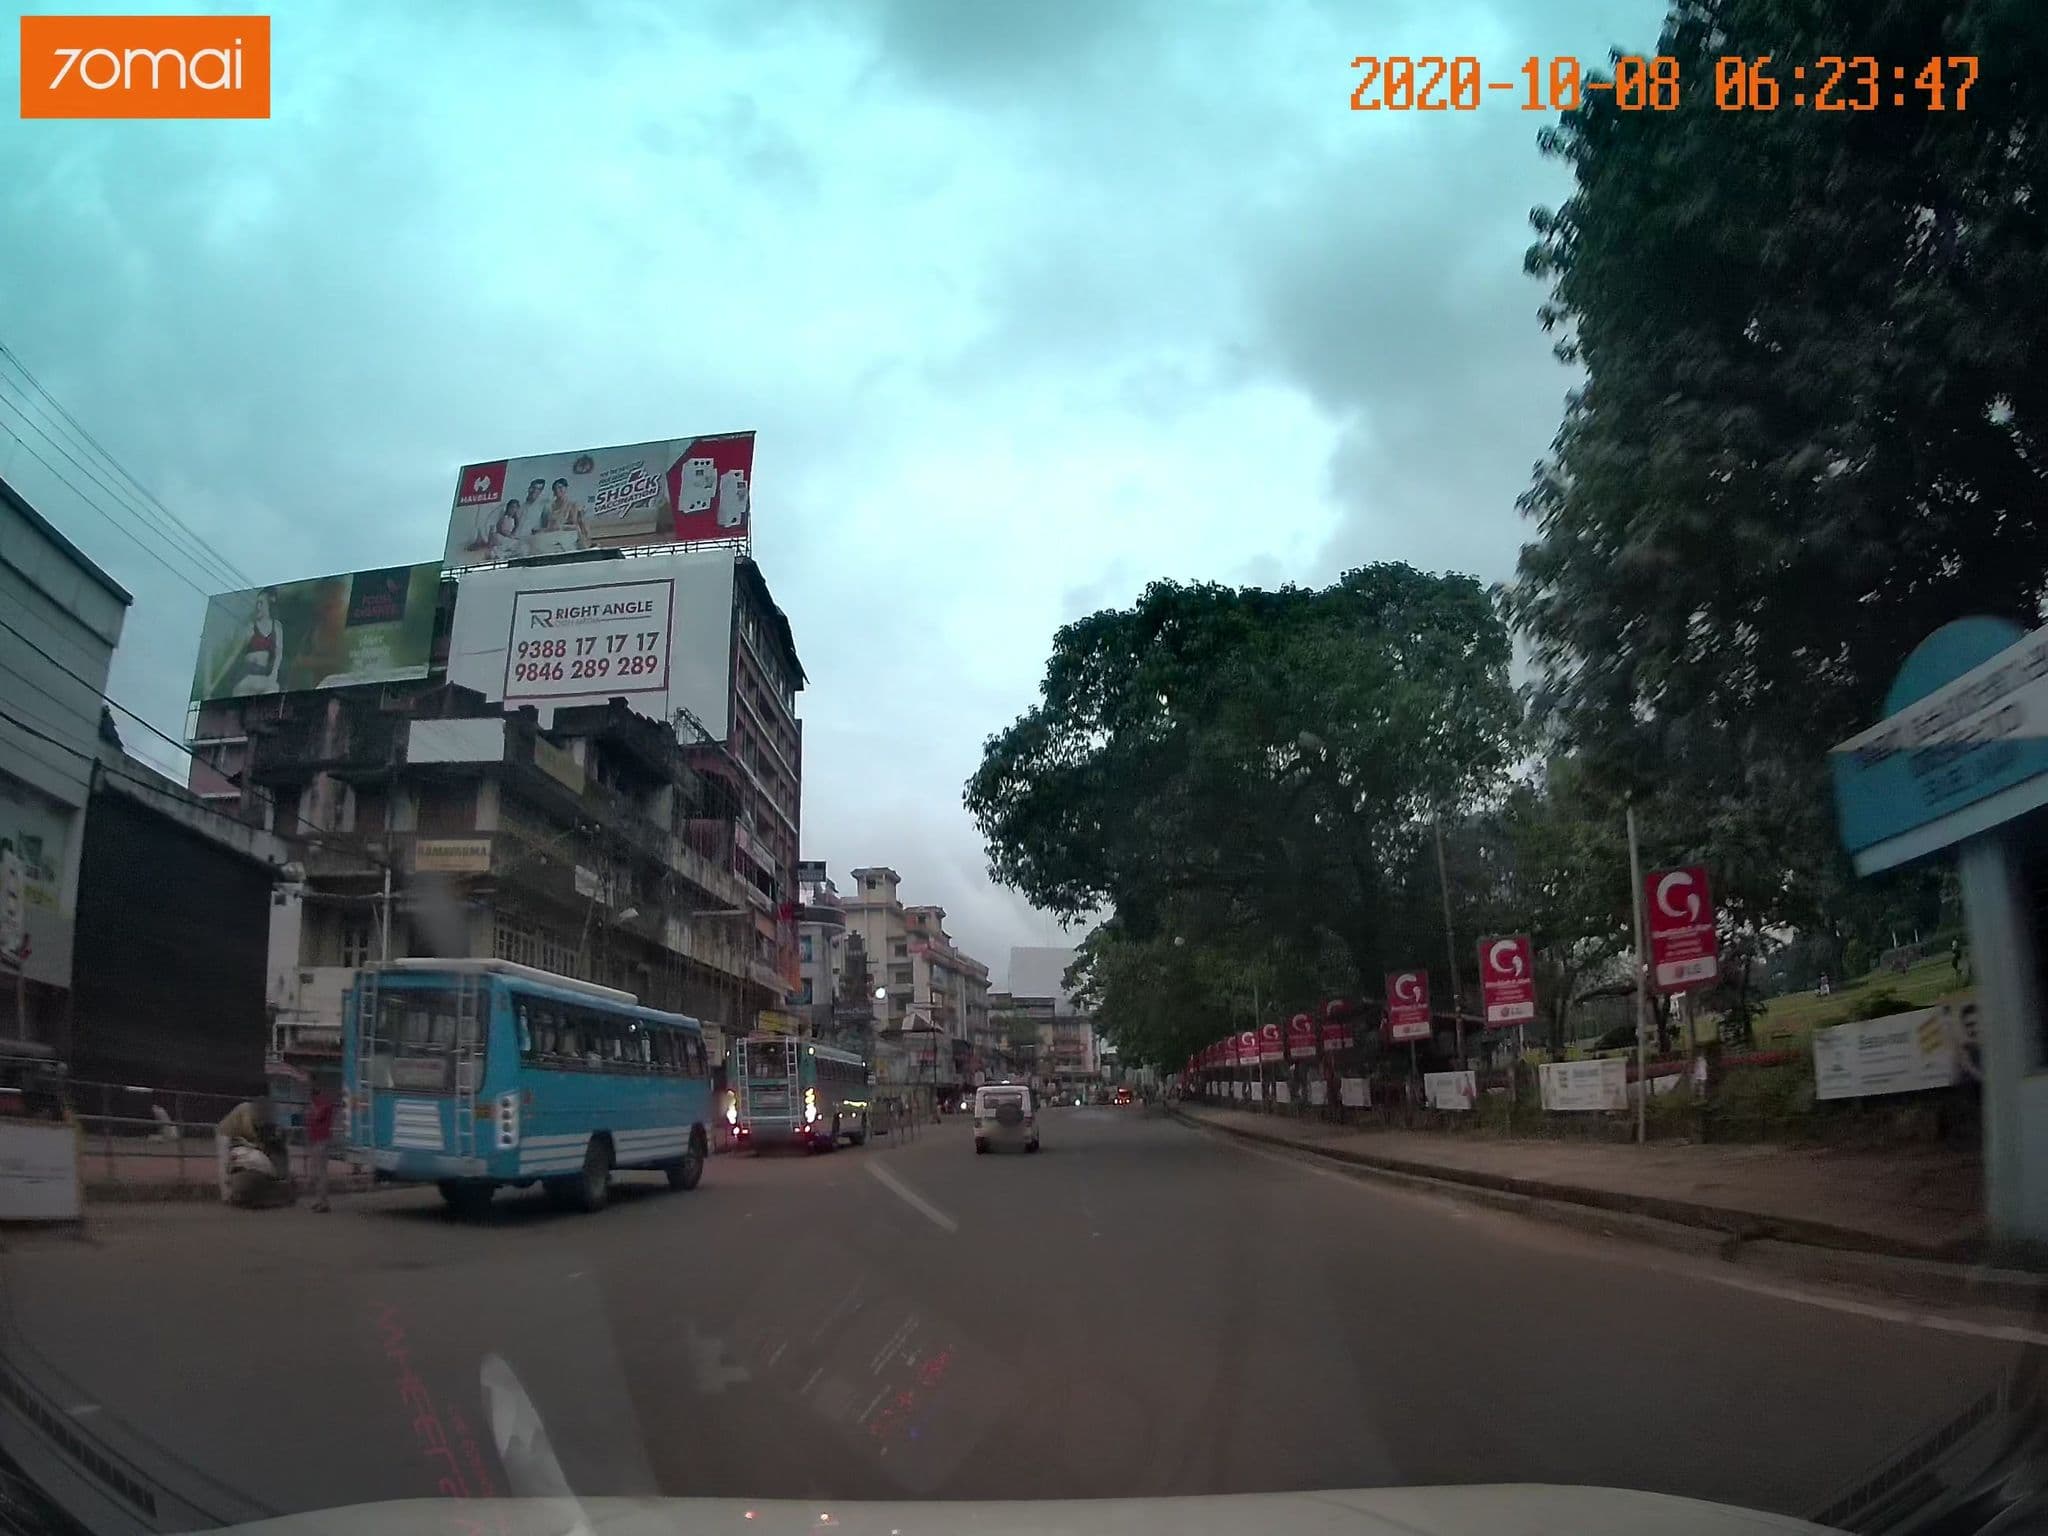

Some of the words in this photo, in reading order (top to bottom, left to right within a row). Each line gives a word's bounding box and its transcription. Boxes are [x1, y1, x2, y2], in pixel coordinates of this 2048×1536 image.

[593, 488, 660, 513] VACCINATION
[595, 473, 662, 506] SHOCK
[556, 604, 600, 620] RIGHT
[602, 600, 653, 616] ANGLE
[517, 639, 566, 660] 9388
[576, 636, 597, 656] 17
[606, 634, 629, 654] 17
[637, 632, 660, 652] 17
[515, 661, 563, 682] 9846
[571, 658, 610, 679] 289
[617, 655, 658, 676] 289
